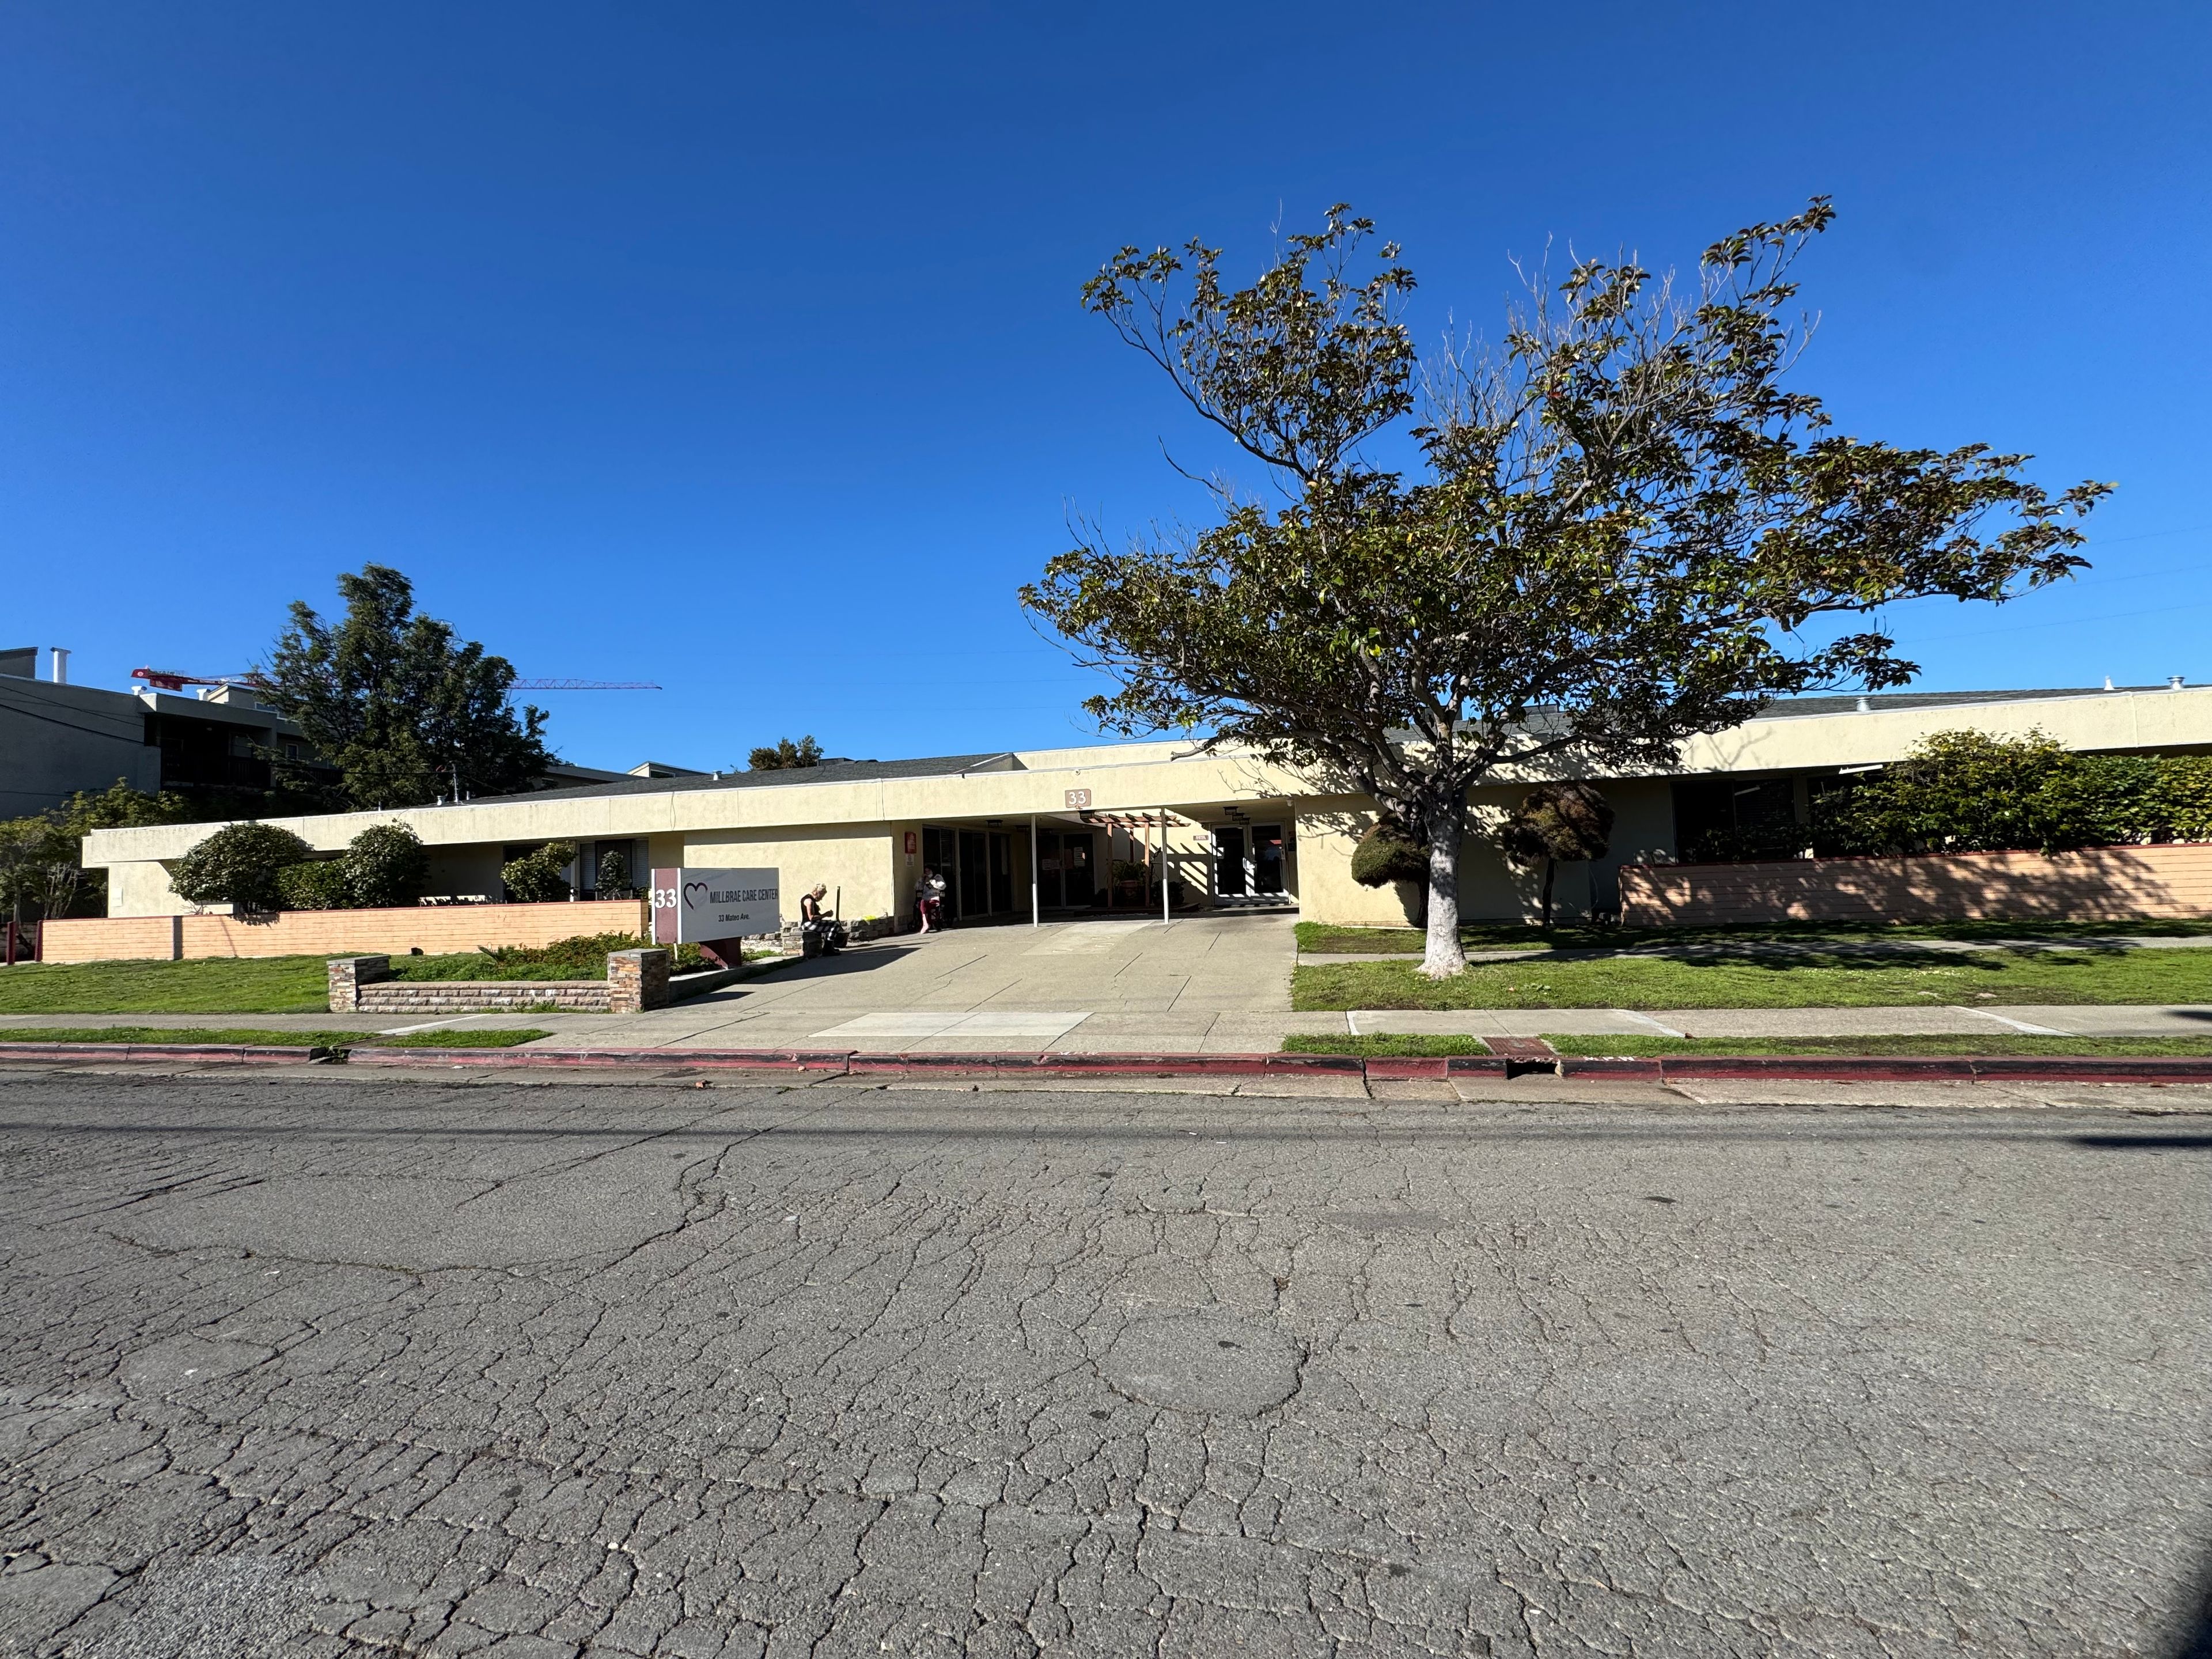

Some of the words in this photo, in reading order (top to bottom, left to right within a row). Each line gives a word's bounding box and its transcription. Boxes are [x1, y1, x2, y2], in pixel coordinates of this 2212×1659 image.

[1069, 791, 1086, 805] 33
[655, 888, 677, 908] 33
[710, 890, 741, 903] MILLBRAE
[743, 889, 757, 902] CARE
[758, 888, 778, 900] CENTER
